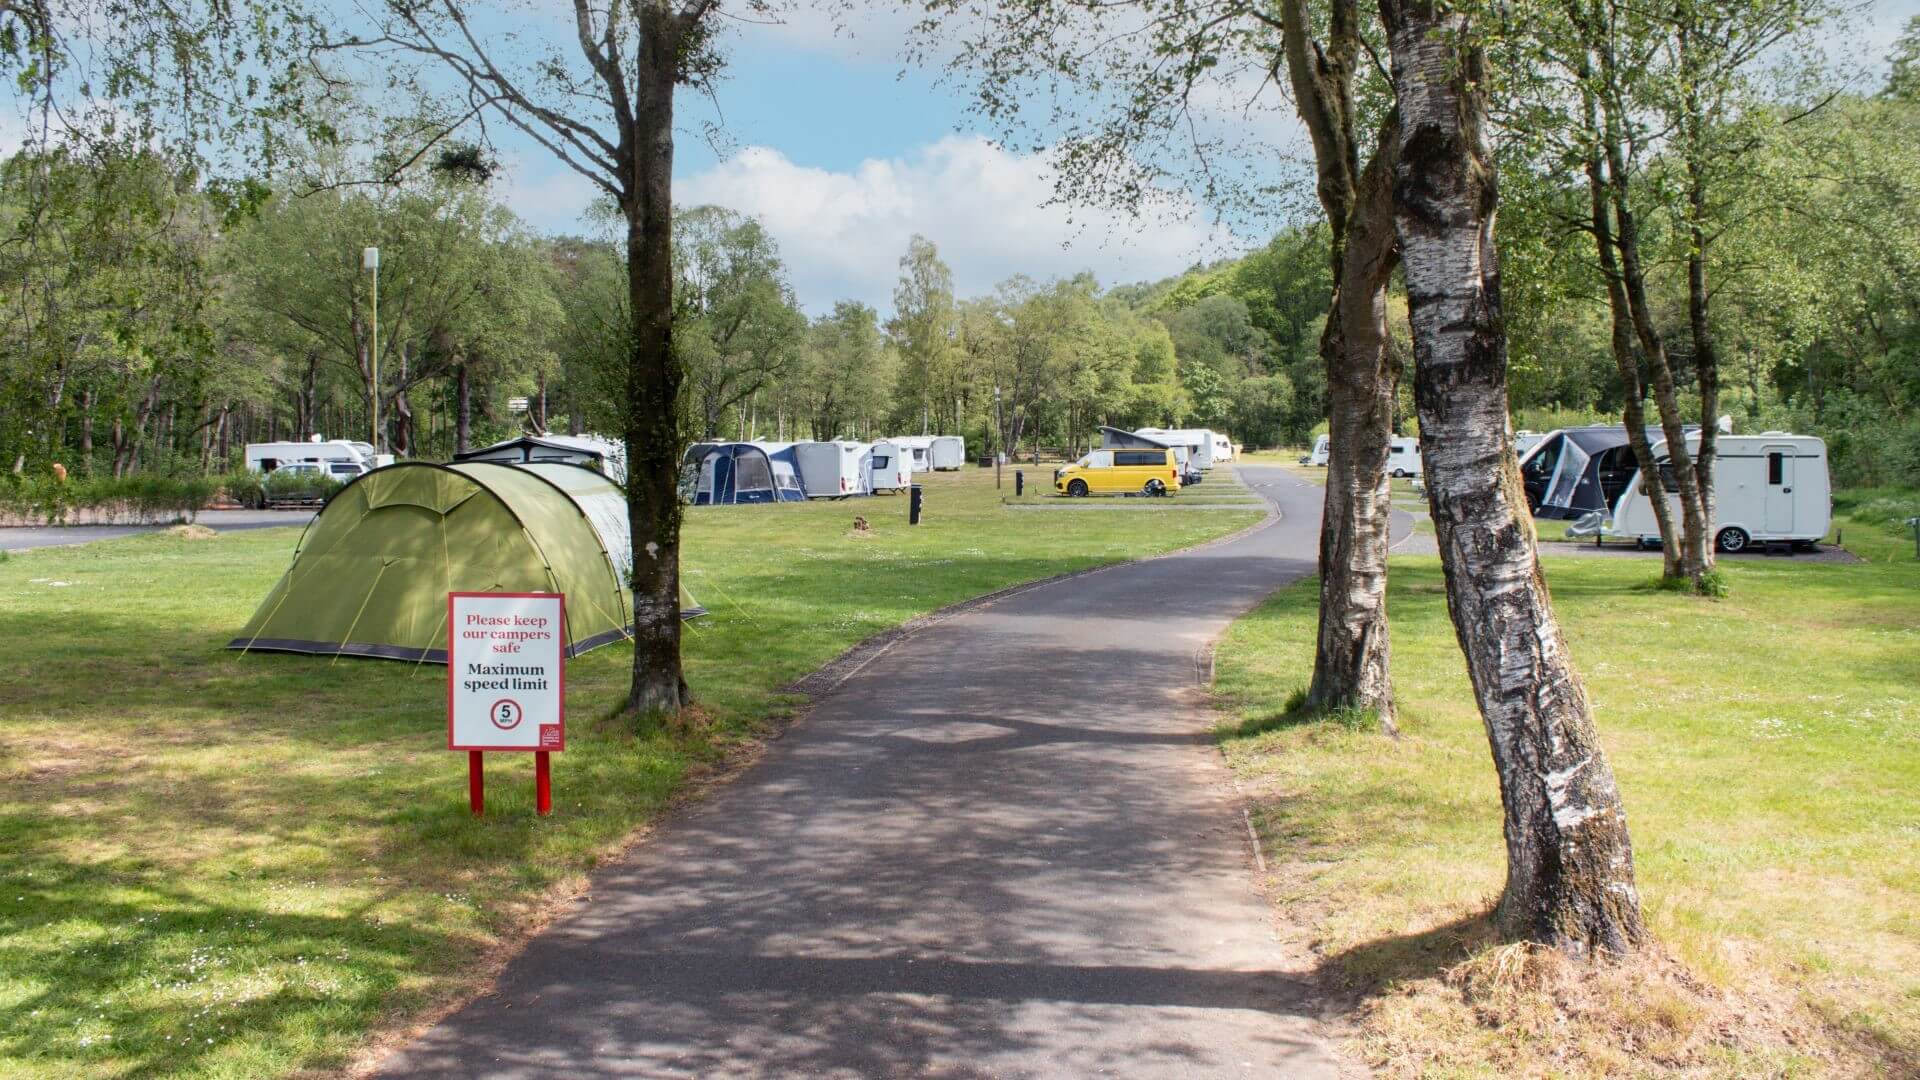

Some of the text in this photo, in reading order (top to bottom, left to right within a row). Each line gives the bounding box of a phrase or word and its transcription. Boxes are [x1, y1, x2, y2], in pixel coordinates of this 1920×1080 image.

[466, 614, 548, 629] Please keep
[462, 630, 551, 643] our campers
[492, 642, 521, 654] safe
[468, 663, 545, 676] Maximum
[464, 677, 548, 692] speed limit
[501, 704, 511, 718] 5
